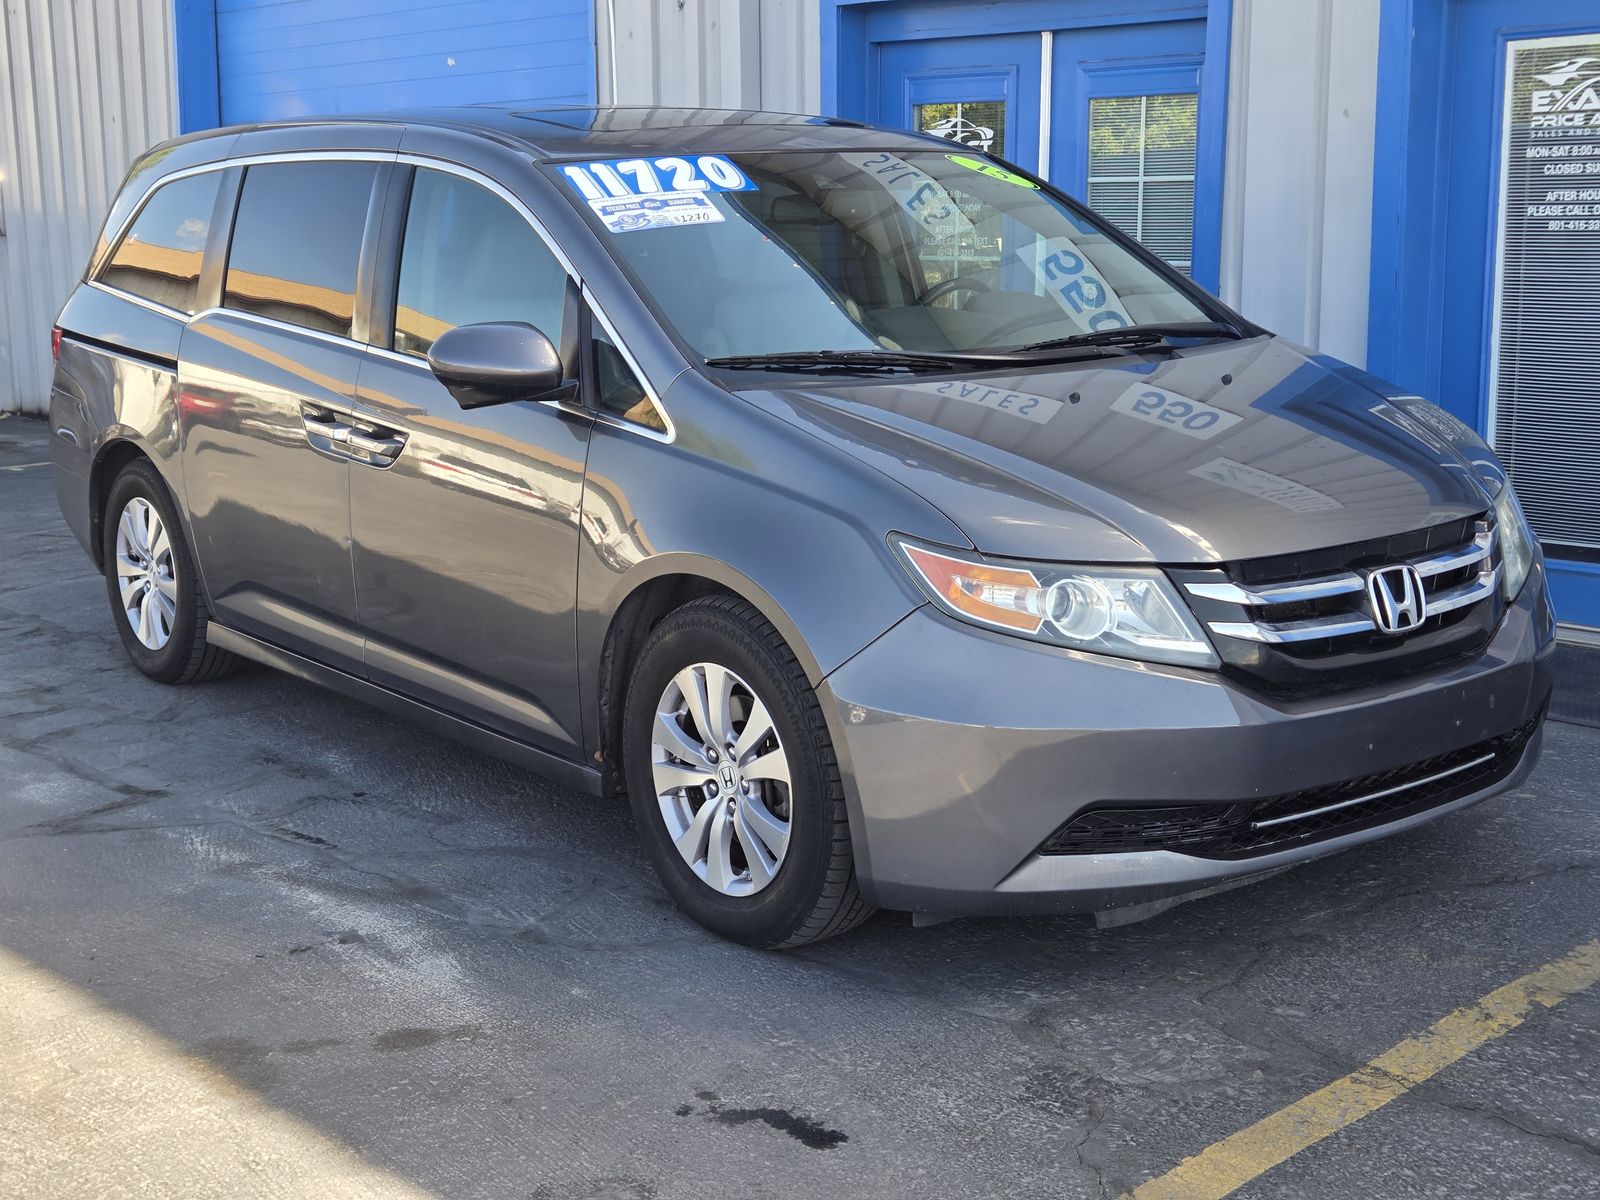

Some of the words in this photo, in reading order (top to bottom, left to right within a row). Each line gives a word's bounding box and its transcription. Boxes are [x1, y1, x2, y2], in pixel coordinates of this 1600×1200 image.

[1531, 113, 1585, 128] PRICE
[1531, 130, 1563, 138] SALES
[1526, 145, 1570, 158] MON-SAT
[1544, 164, 1583, 175] CLOSED
[564, 156, 746, 200] 11720
[1546, 191, 1578, 201] AFTER
[1527, 206, 1563, 216] PLEASE
[1565, 205, 1590, 215] CALL
